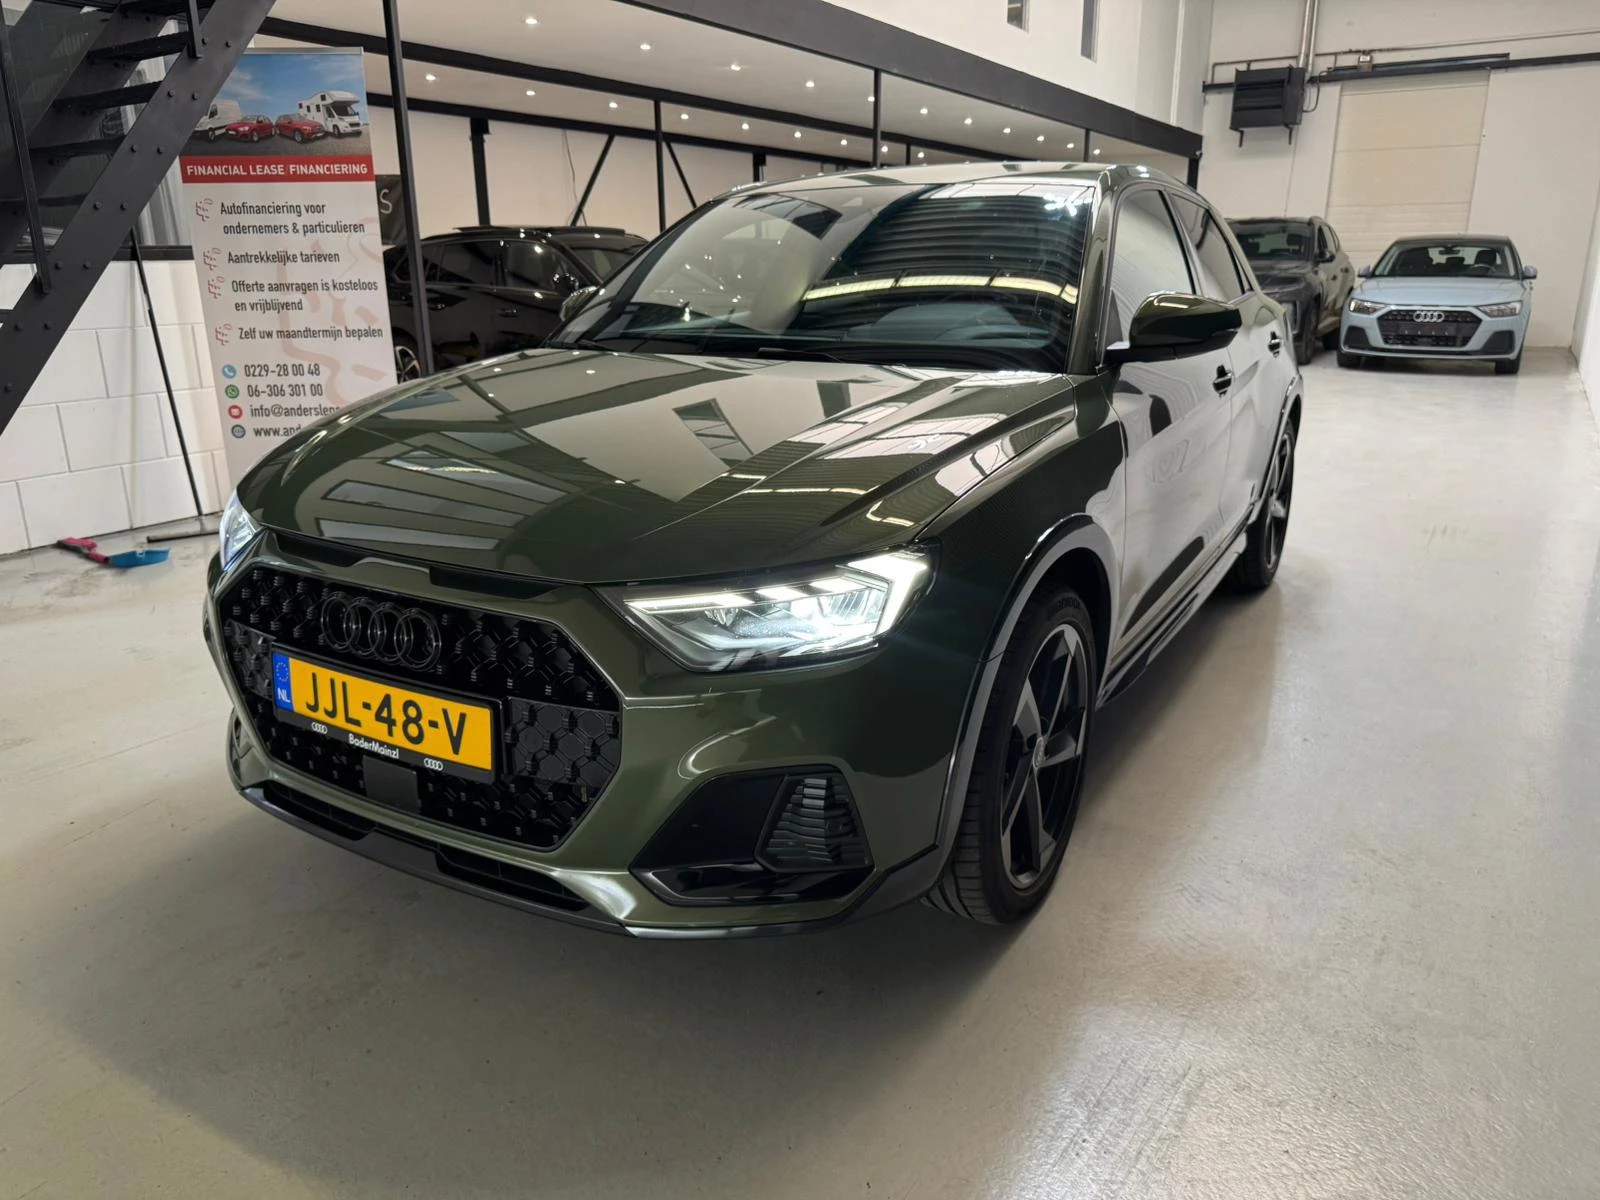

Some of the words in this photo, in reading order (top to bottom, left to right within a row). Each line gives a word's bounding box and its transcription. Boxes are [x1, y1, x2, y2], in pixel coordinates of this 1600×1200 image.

[186, 164, 246, 176] FINANCIAL
[249, 164, 285, 175] LEASE
[289, 163, 368, 175] FINANCIERING
[220, 201, 302, 217] Autofinanciering
[304, 204, 326, 215] voor
[223, 222, 289, 235] ondernemers
[292, 223, 300, 234] &
[302, 221, 365, 237] particulieren
[227, 252, 298, 266] Aantrekkelijke
[300, 251, 340, 263] tarieven
[231, 280, 265, 293] Offerte
[267, 281, 319, 295] aanvragen
[321, 280, 330, 291] is
[332, 278, 378, 291] kosteloos
[234, 302, 247, 312] en
[249, 299, 303, 315] vrijblijvend
[238, 327, 257, 340] Zelf
[259, 329, 274, 340] uw
[276, 326, 343, 341] maandtermijn
[345, 325, 384, 341] bepalen
[244, 364, 290, 377] 0229-28
[291, 364, 305, 377] 00
[307, 363, 321, 377] 48
[247, 384, 286, 398] 06-306
[287, 383, 306, 397] 301
[310, 383, 324, 397] 00
[250, 403, 340, 418] info@anderslen
[277, 687, 291, 704] NL
[305, 672, 467, 756] JJL-48-V
